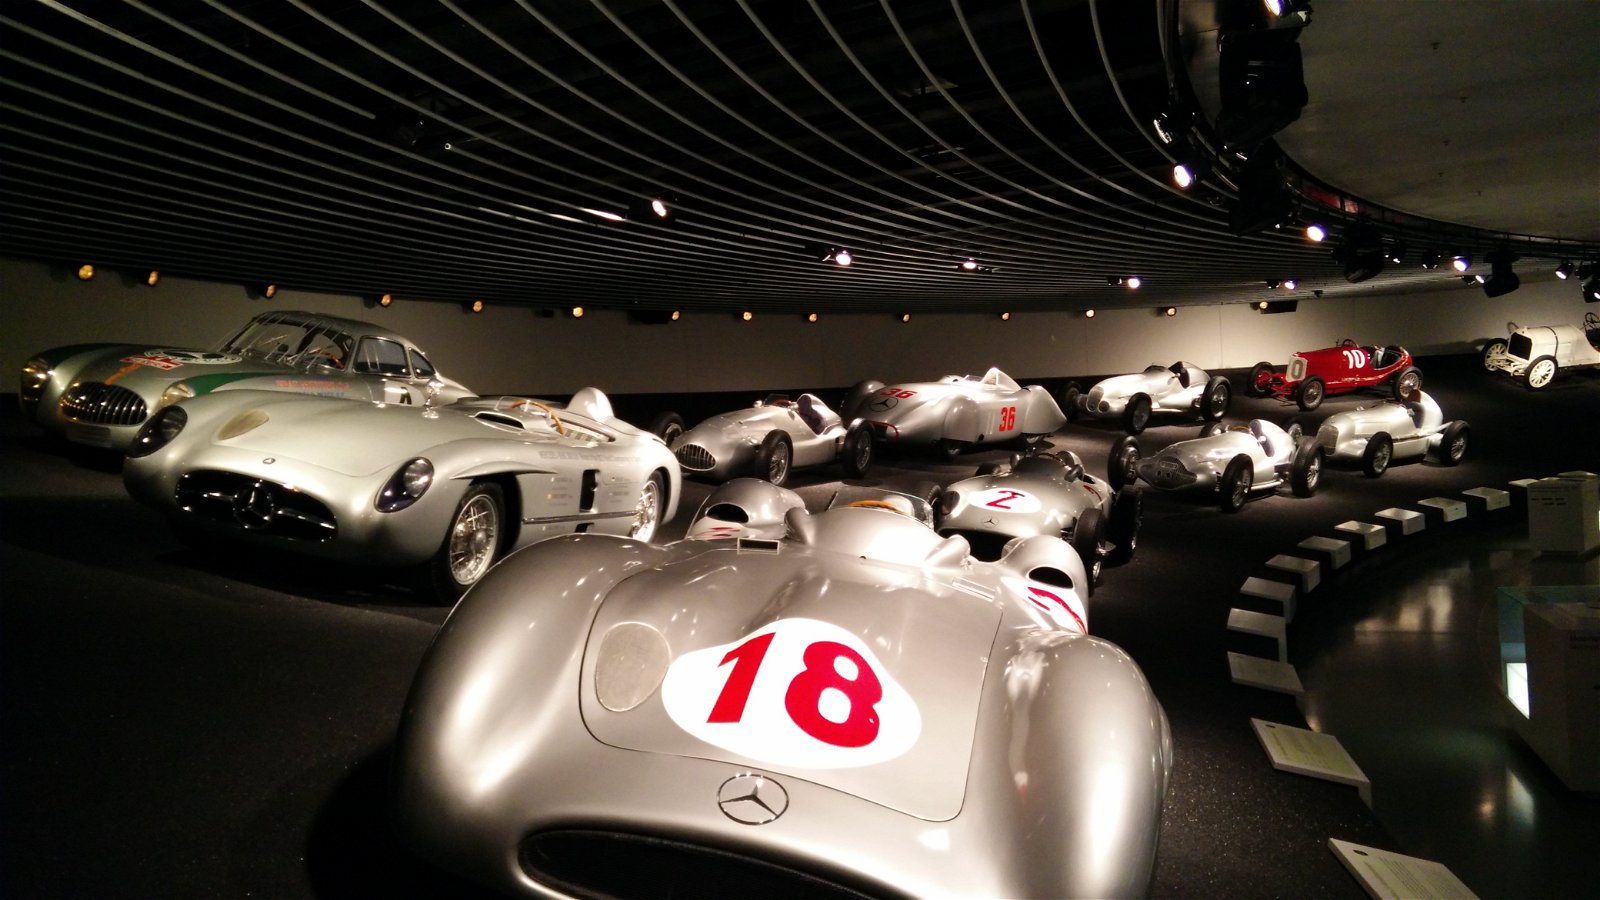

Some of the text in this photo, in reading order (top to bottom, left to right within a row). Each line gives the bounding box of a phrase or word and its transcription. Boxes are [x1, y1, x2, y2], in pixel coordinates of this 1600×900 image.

[1342, 349, 1366, 369] 10
[879, 387, 918, 399] 36
[998, 406, 1016, 433] 36
[985, 490, 1025, 510] 2
[706, 631, 883, 748] 18
